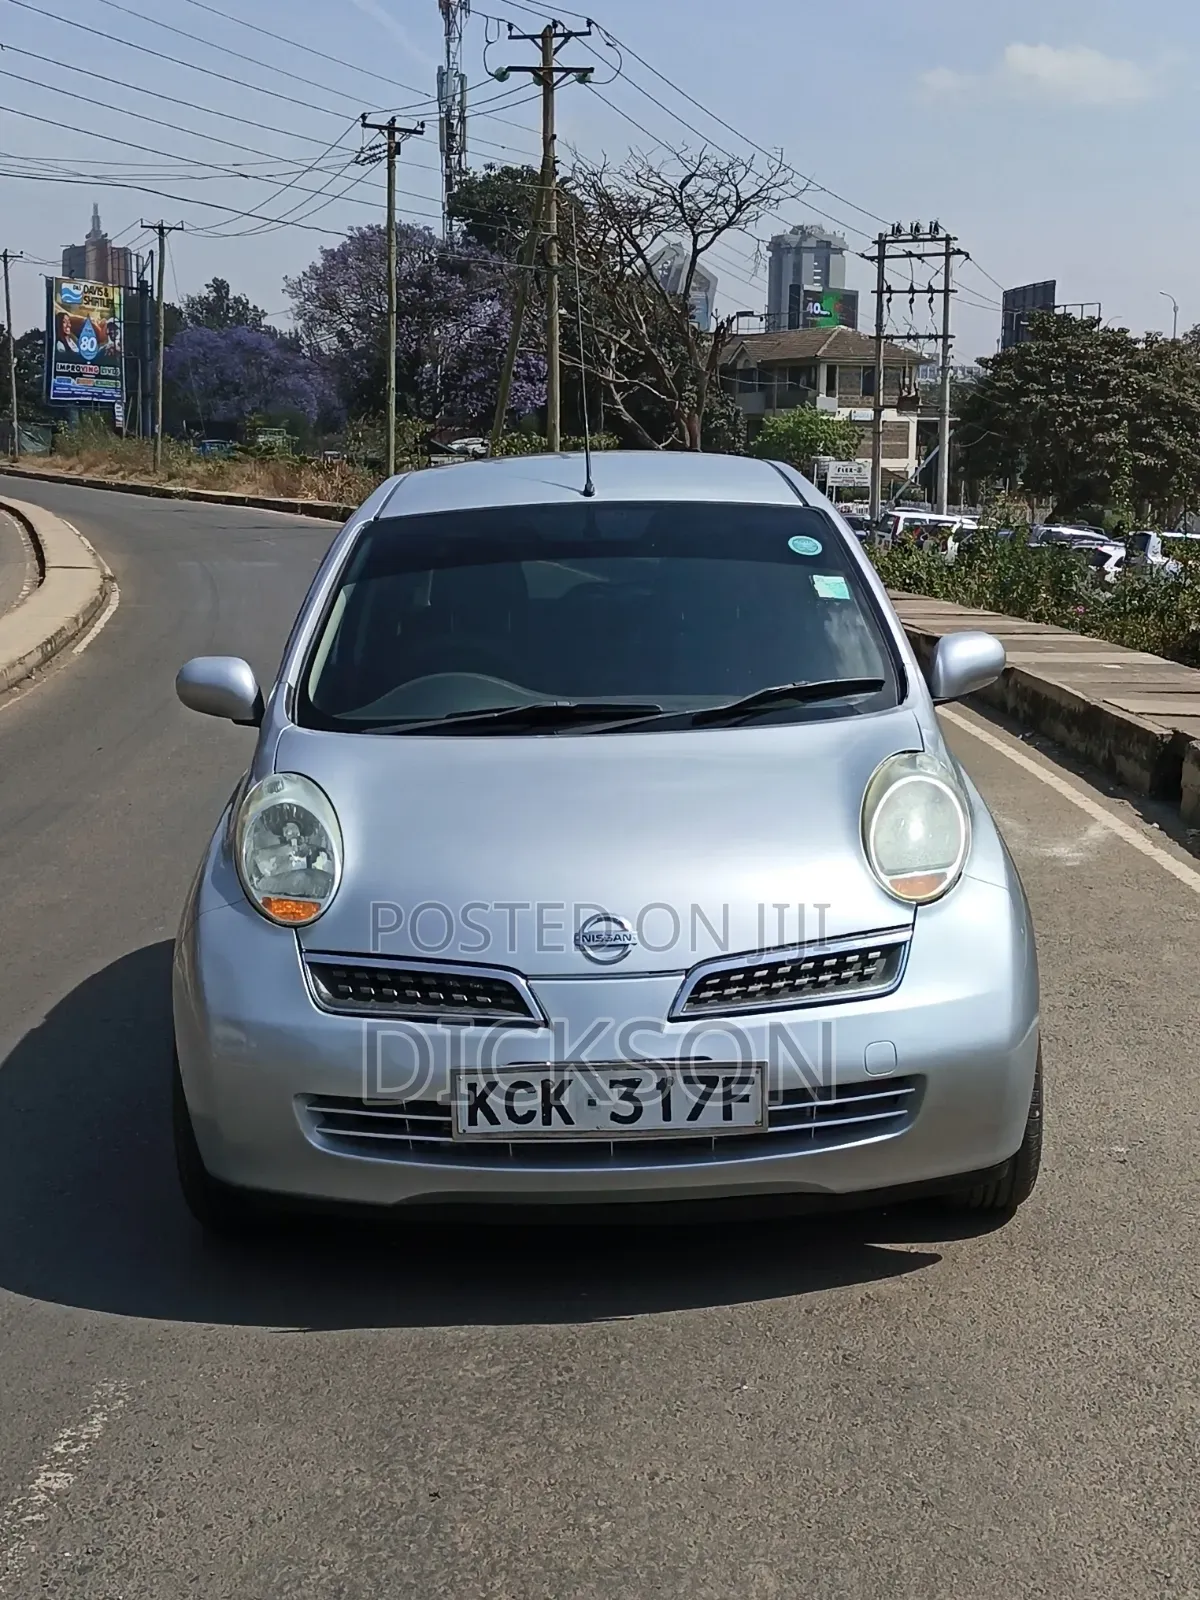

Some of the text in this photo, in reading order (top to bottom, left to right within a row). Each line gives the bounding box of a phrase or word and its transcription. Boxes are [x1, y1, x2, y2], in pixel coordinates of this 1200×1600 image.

[83, 284, 109, 297] DAVIS &
[81, 336, 97, 352] 80
[56, 363, 99, 375] IMPROVING
[581, 933, 632, 943] NISSAN
[467, 1076, 756, 1127] KCK 317F
